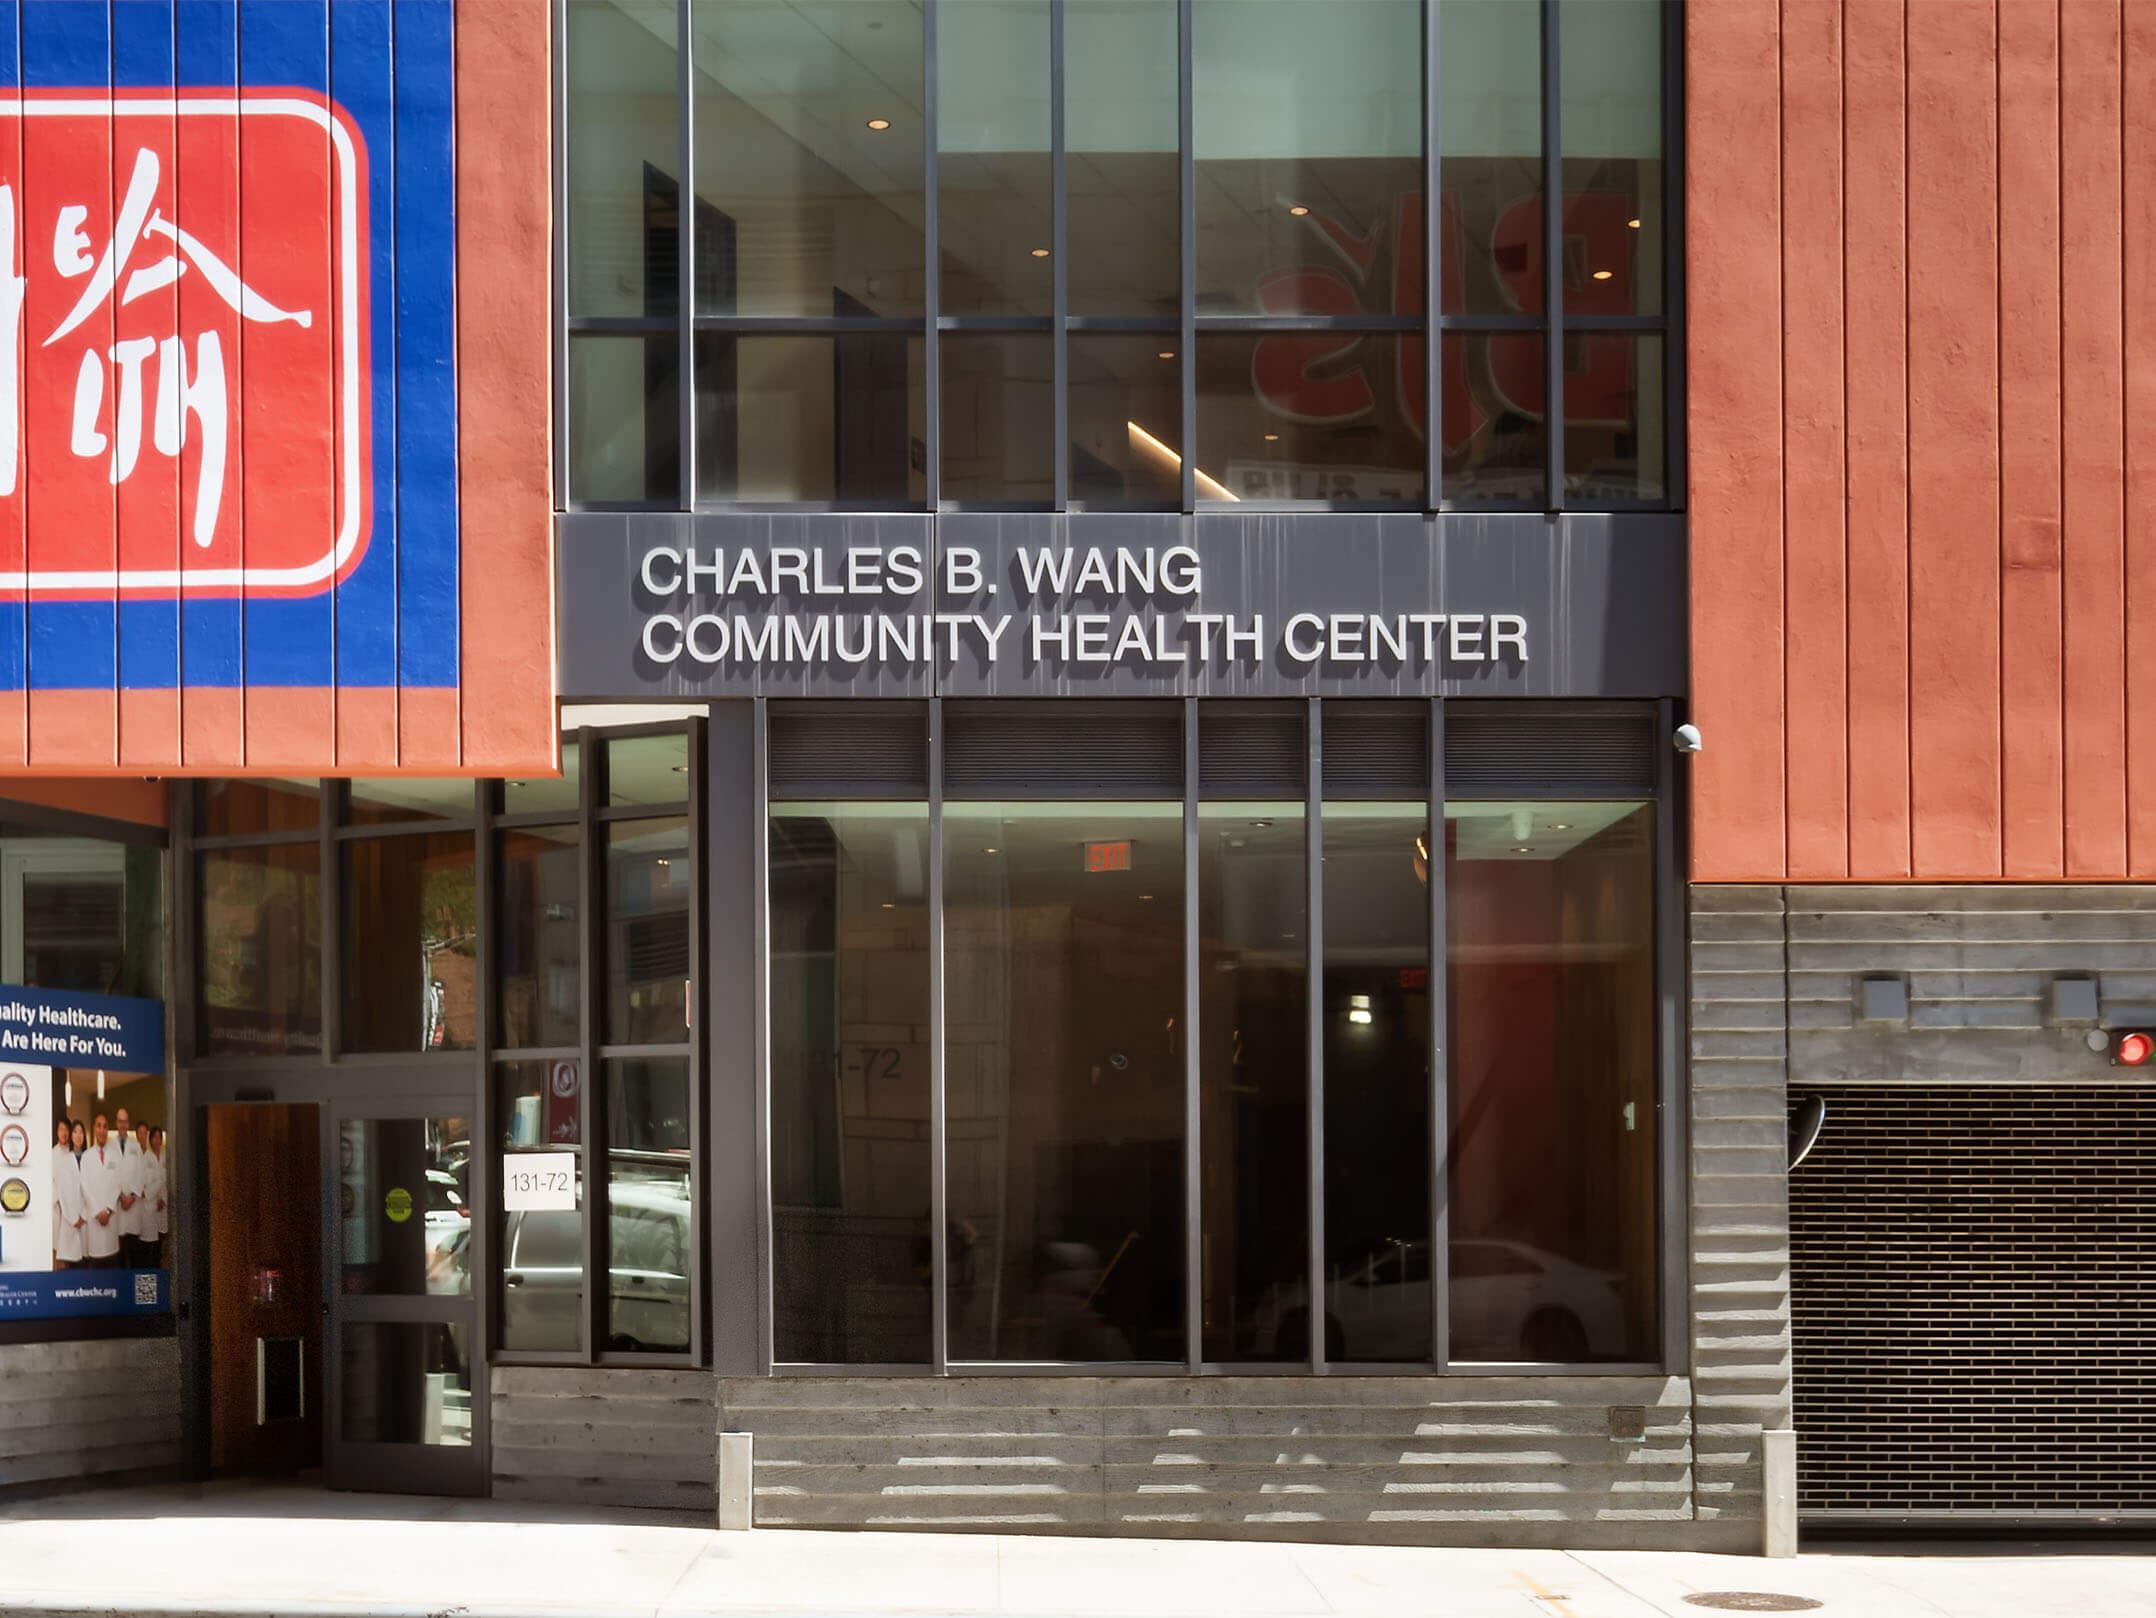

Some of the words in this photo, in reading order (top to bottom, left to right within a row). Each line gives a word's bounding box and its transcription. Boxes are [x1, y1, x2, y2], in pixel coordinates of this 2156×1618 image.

[641, 546, 923, 595] CHARLES
[946, 547, 997, 594] B.
[1017, 546, 1202, 594] WANG
[642, 614, 1012, 662] COMMUNITY
[1032, 614, 1264, 661] HEALTH
[1284, 614, 1529, 661] CENTER
[1090, 844, 1128, 871] EXIT
[0, 1001, 36, 1027] ality
[39, 1004, 122, 1030] Healthcare.
[2, 1029, 29, 1050] Are
[31, 1032, 67, 1052] Here
[70, 1035, 94, 1054] For
[95, 1037, 126, 1057] You.
[511, 1172, 568, 1192] 131-72
